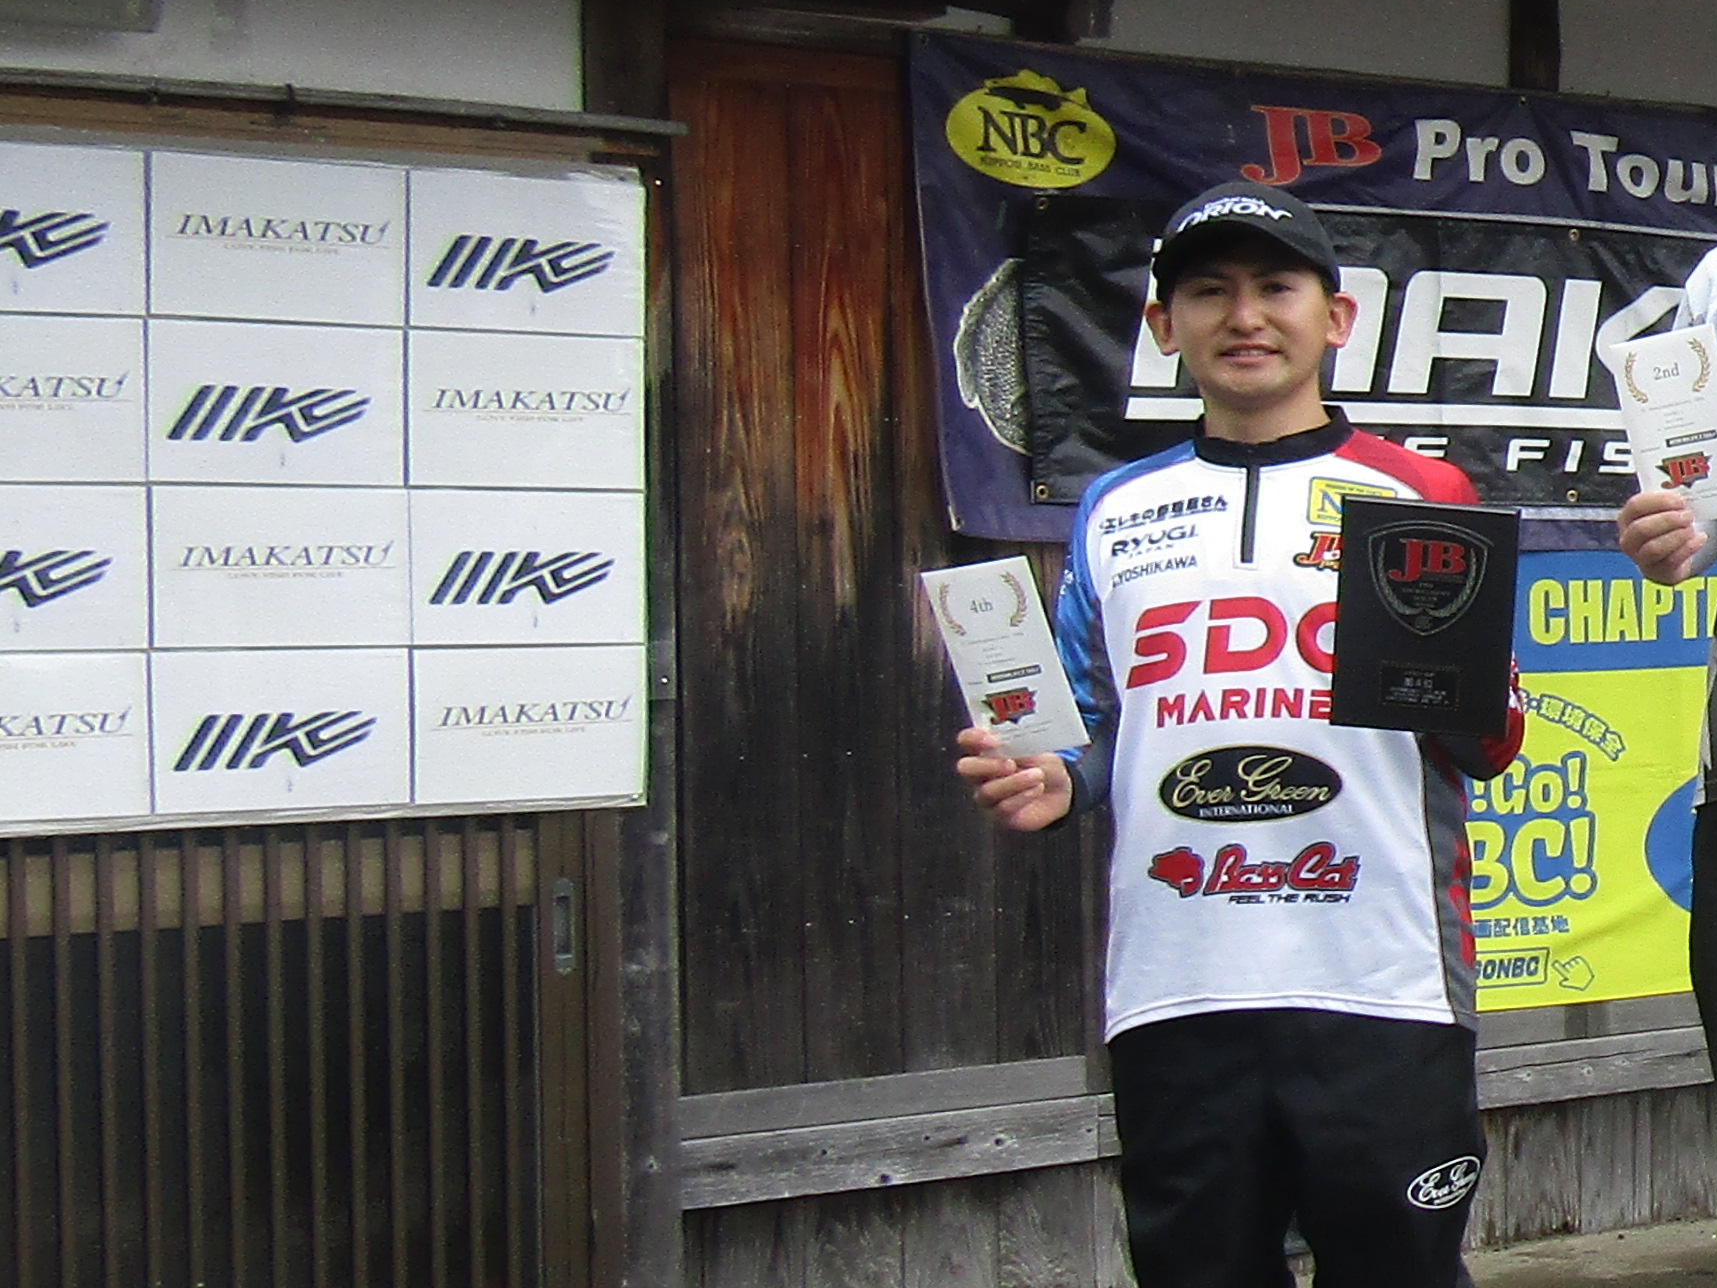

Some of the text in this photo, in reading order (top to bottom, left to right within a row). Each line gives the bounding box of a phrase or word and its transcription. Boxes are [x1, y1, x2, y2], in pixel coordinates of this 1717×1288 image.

[977, 105, 1087, 166] NBC
[1242, 104, 1382, 185] JB
[1413, 118, 1546, 186] Pro
[177, 213, 390, 245] IMAKATSU
[1653, 362, 1680, 381] 2nd
[432, 387, 631, 413] IMAKATSU
[179, 540, 394, 567] IMAKATSU
[1112, 524, 1199, 557] RYUGI
[1388, 538, 1468, 582] JB
[969, 598, 993, 614] 4th
[438, 693, 634, 727] IMAKATSU
[1172, 755, 1332, 808] Ever Green
[1199, 803, 1295, 818] INTERNATIONAL
[1203, 841, 1361, 896] Bass Cat
[1228, 893, 1351, 905] FEEL THE RUSH
